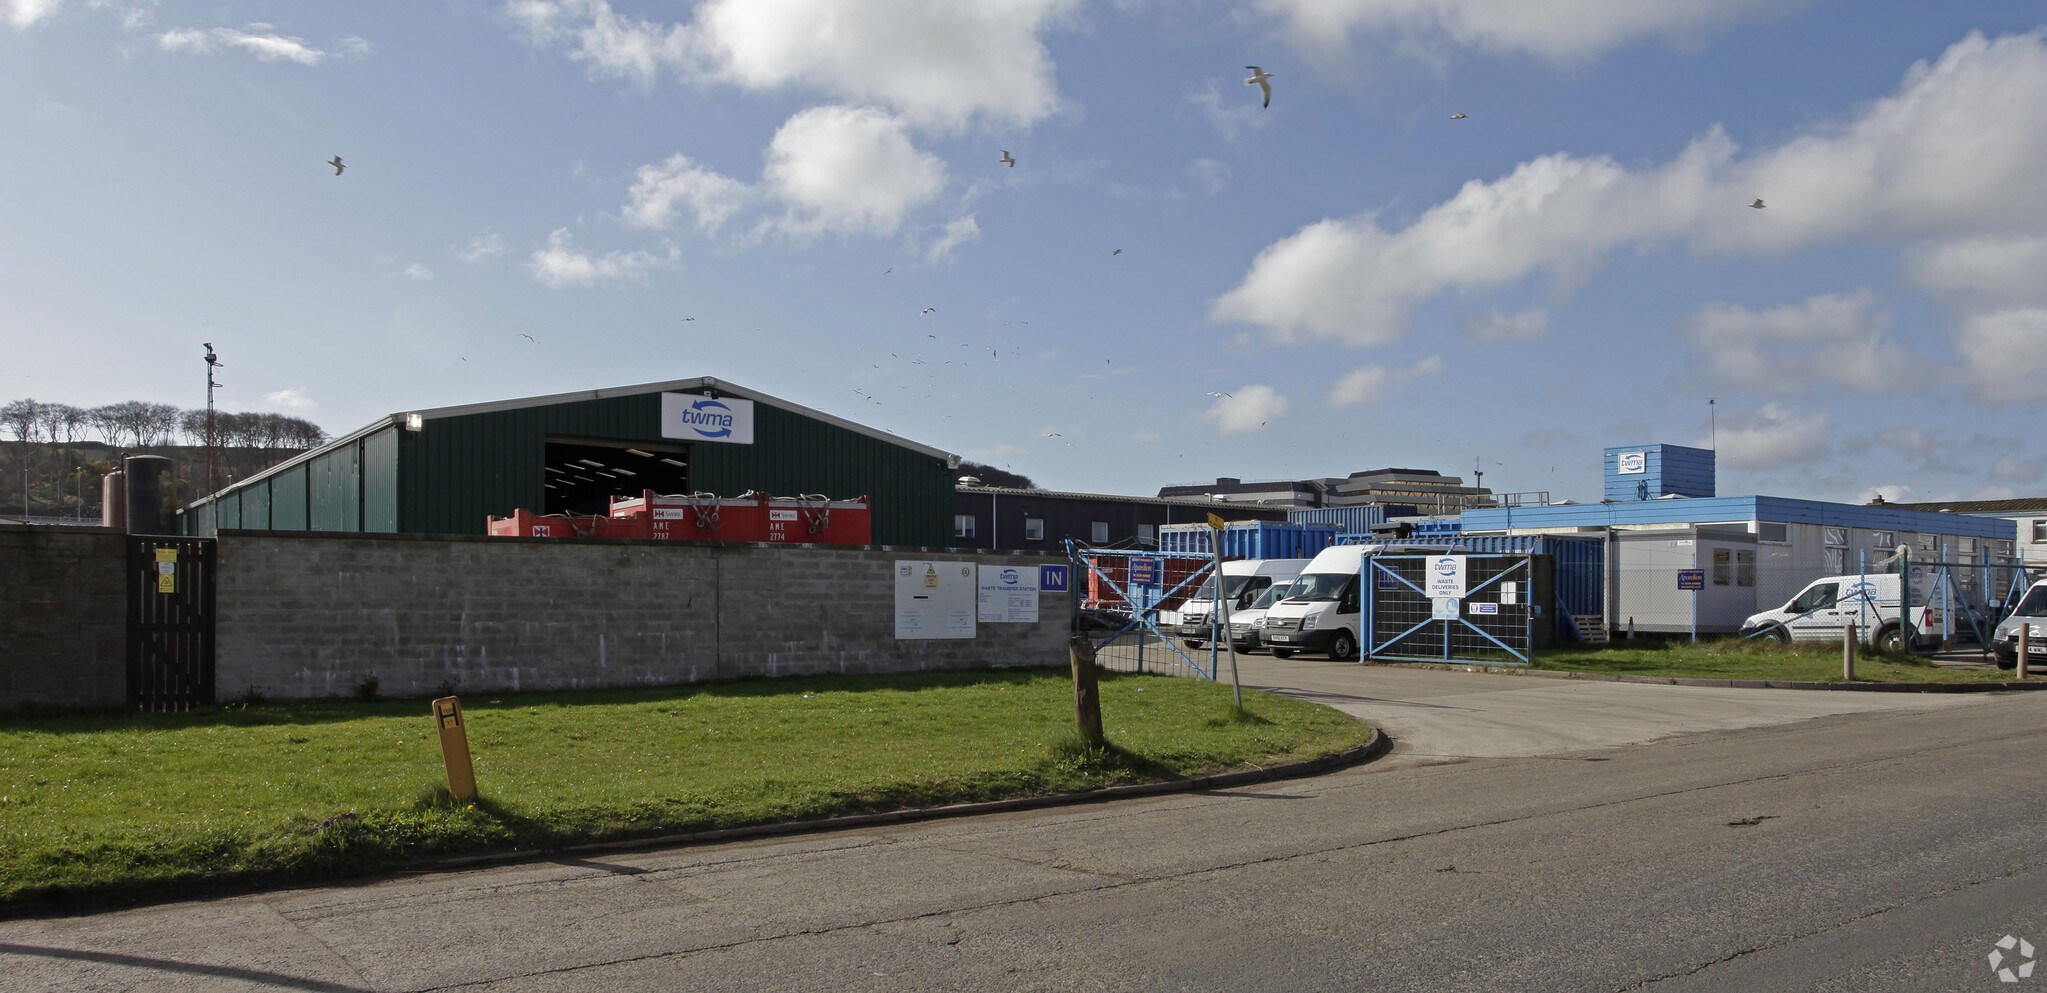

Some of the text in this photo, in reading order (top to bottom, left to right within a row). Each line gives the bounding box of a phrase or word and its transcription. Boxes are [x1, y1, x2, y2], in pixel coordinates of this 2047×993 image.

[682, 408, 733, 427] twma
[1435, 562, 1456, 570] twma
[1046, 571, 1062, 586] IN
[1383, 571, 1395, 584] IN
[438, 702, 459, 729] H
